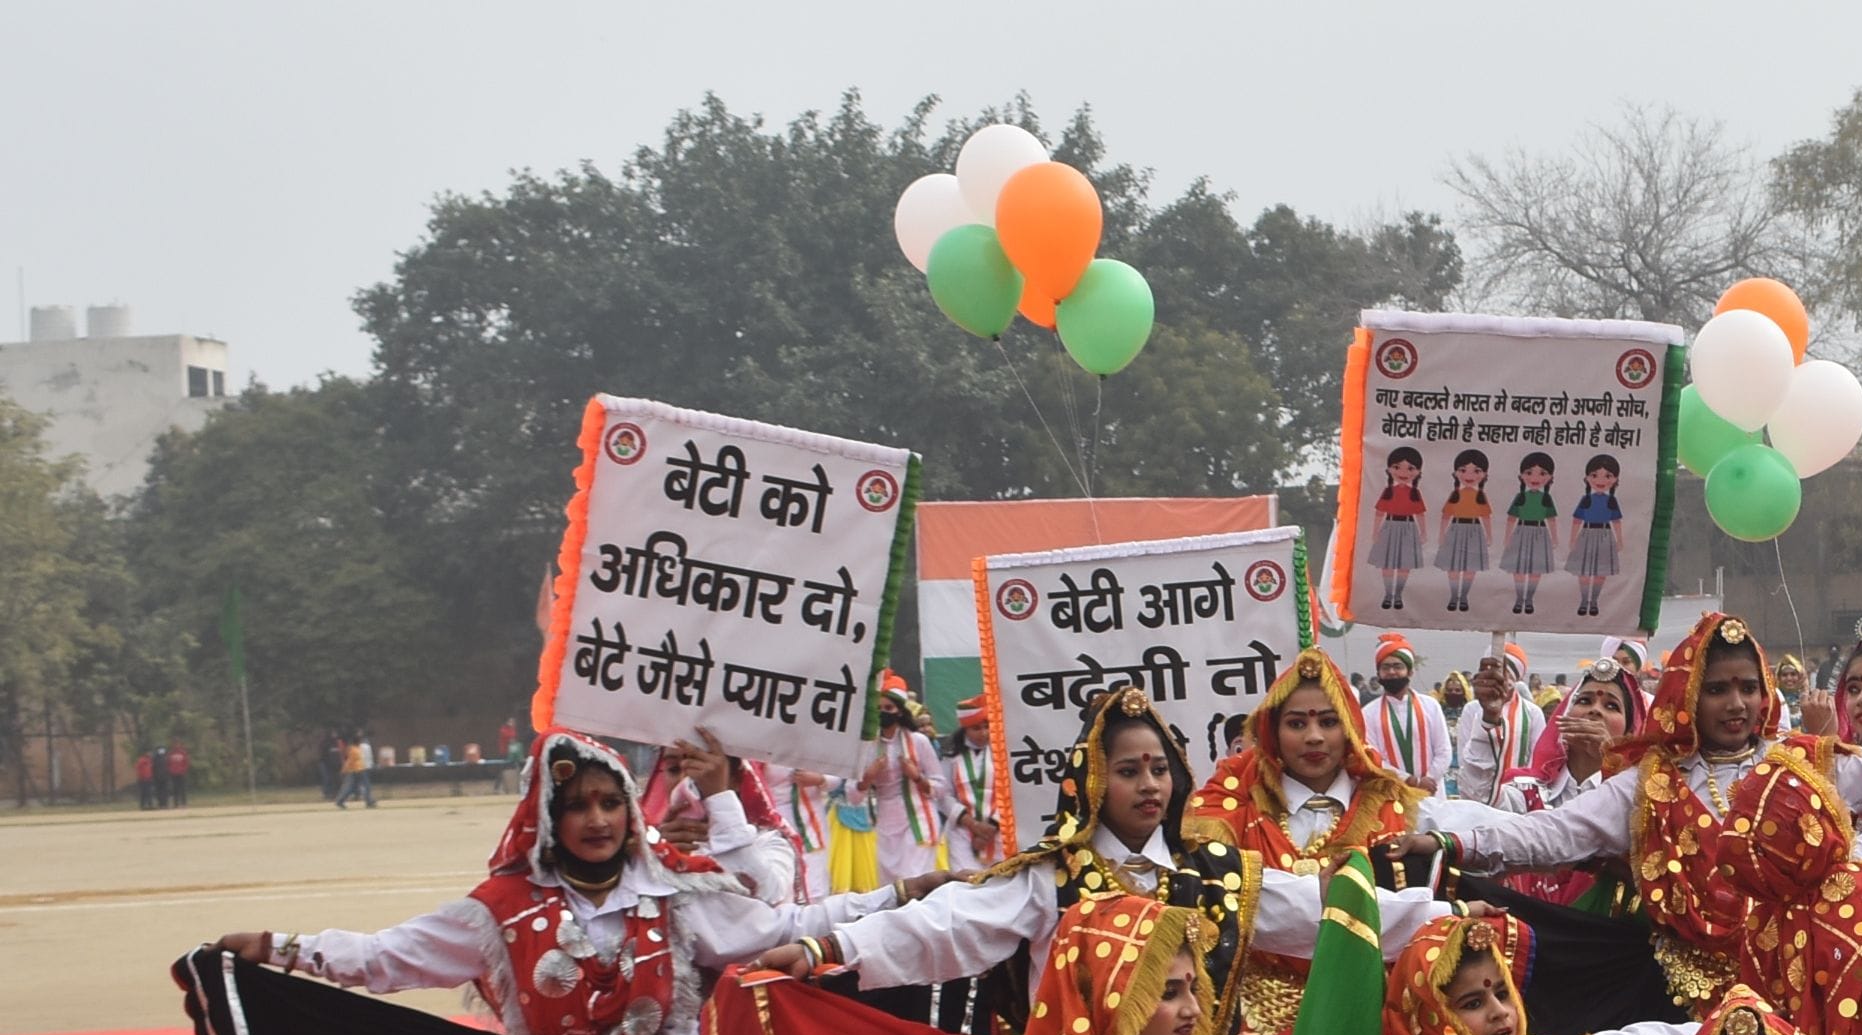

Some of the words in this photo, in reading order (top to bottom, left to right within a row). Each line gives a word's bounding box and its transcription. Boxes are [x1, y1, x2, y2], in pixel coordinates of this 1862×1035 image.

[1376, 389, 1400, 408] नए
[1403, 386, 1450, 410] बदलते
[1453, 394, 1491, 412] भारत
[1494, 389, 1508, 412] मे
[1512, 396, 1547, 414] बदल
[1550, 391, 1568, 415] लो
[1571, 392, 1613, 416] अपनी
[1617, 394, 1648, 418] सोच,
[1382, 413, 1425, 438] बेटियाँ
[1427, 416, 1459, 441] होती
[1462, 417, 1474, 442] है
[1478, 424, 1520, 443] सहारा
[1523, 419, 1552, 445] नही
[1554, 420, 1586, 446] होती
[1590, 422, 1601, 447] है
[664, 440, 750, 518] बेटी
[760, 464, 833, 533] को
[590, 531, 795, 624] अधिकार
[802, 566, 865, 643] दो,
[1048, 568, 1124, 633] बेटी
[1137, 562, 1235, 628] आगे
[574, 618, 632, 691] बेटे
[638, 630, 714, 706] जैसे
[723, 664, 807, 724] प्यार
[812, 664, 856, 732] दो
[1206, 640, 1281, 696] तो
